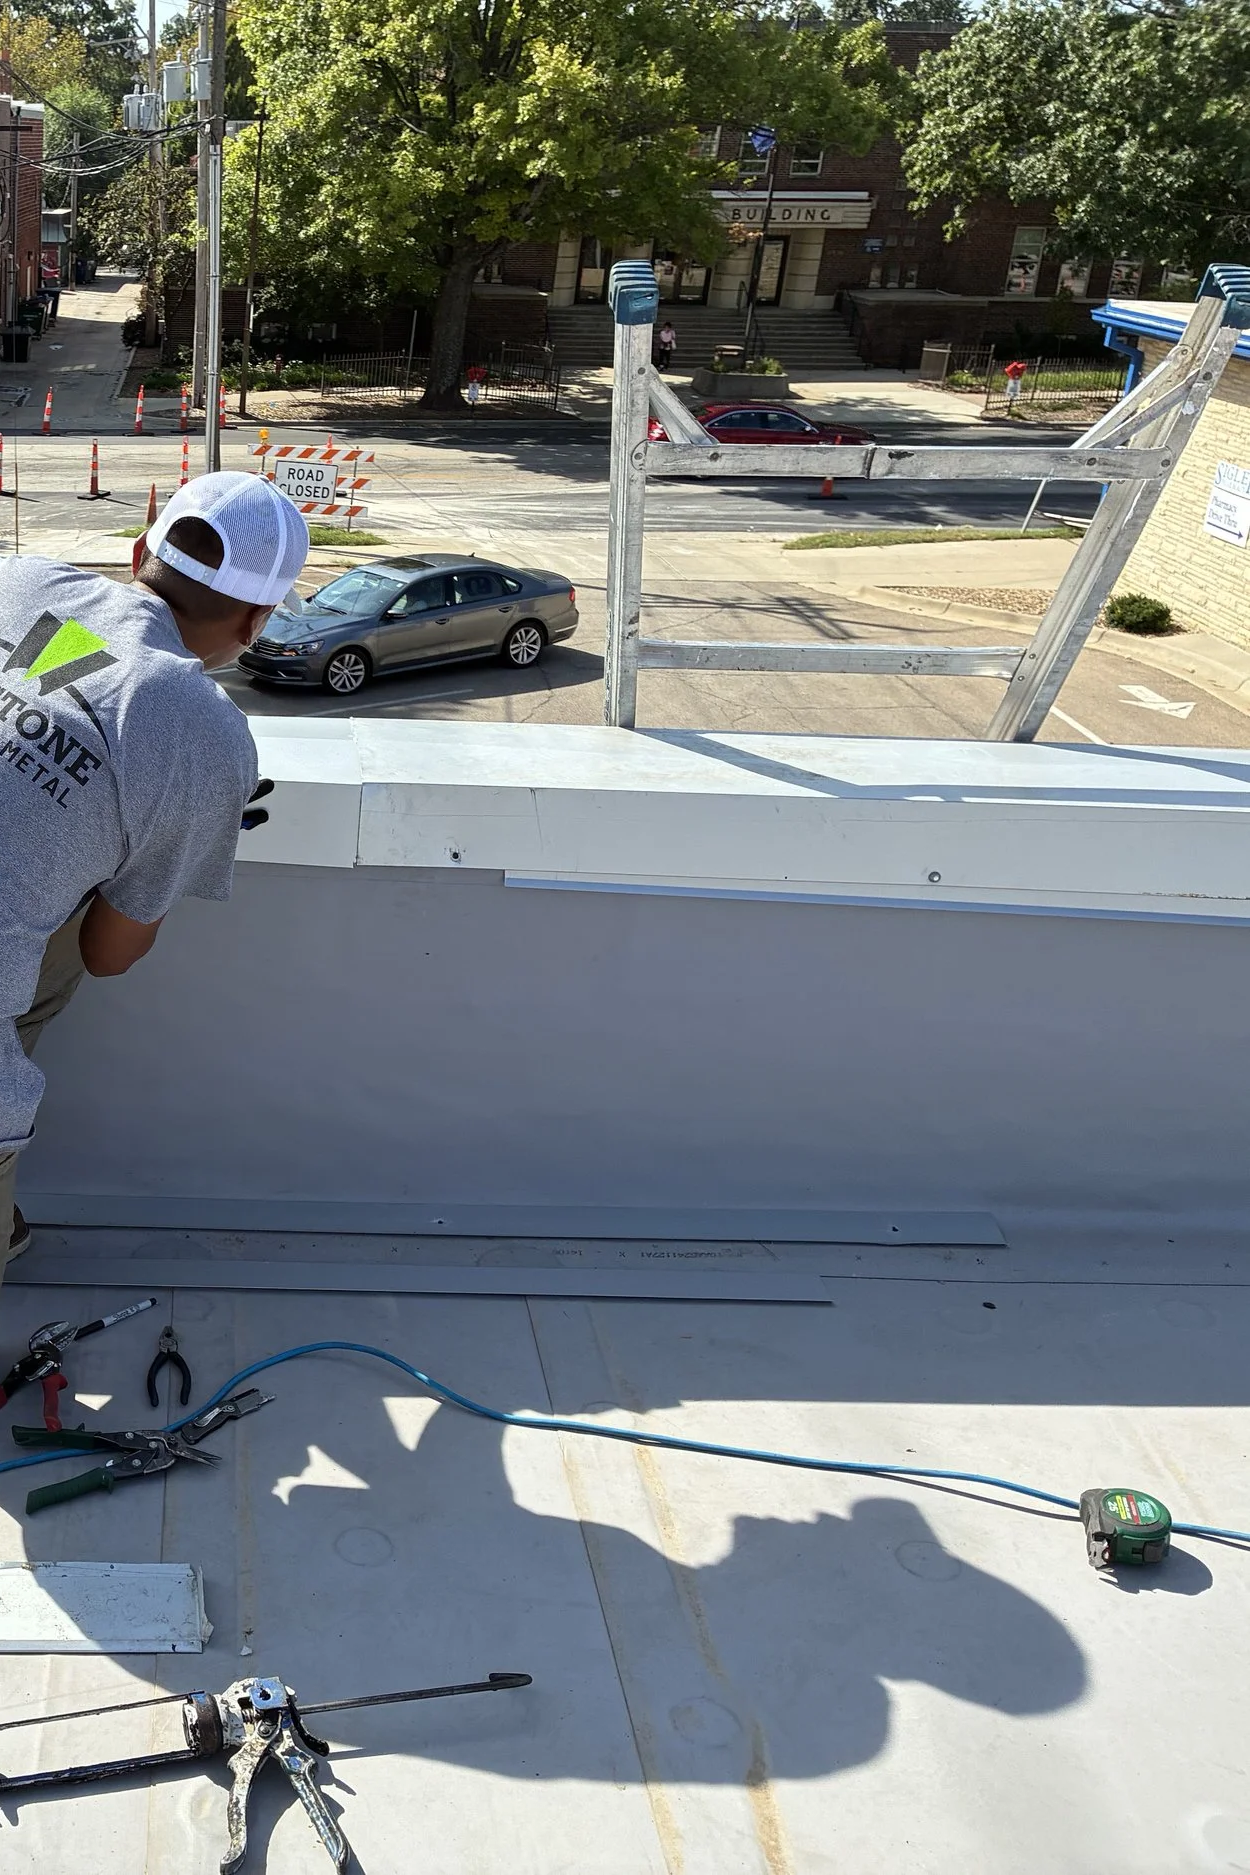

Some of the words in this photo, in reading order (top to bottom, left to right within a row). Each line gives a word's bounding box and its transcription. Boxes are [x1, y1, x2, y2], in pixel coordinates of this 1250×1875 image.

[732, 208, 831, 221] BUILDING
[288, 468, 324, 481] ROAD
[0, 740, 71, 809] METAL
